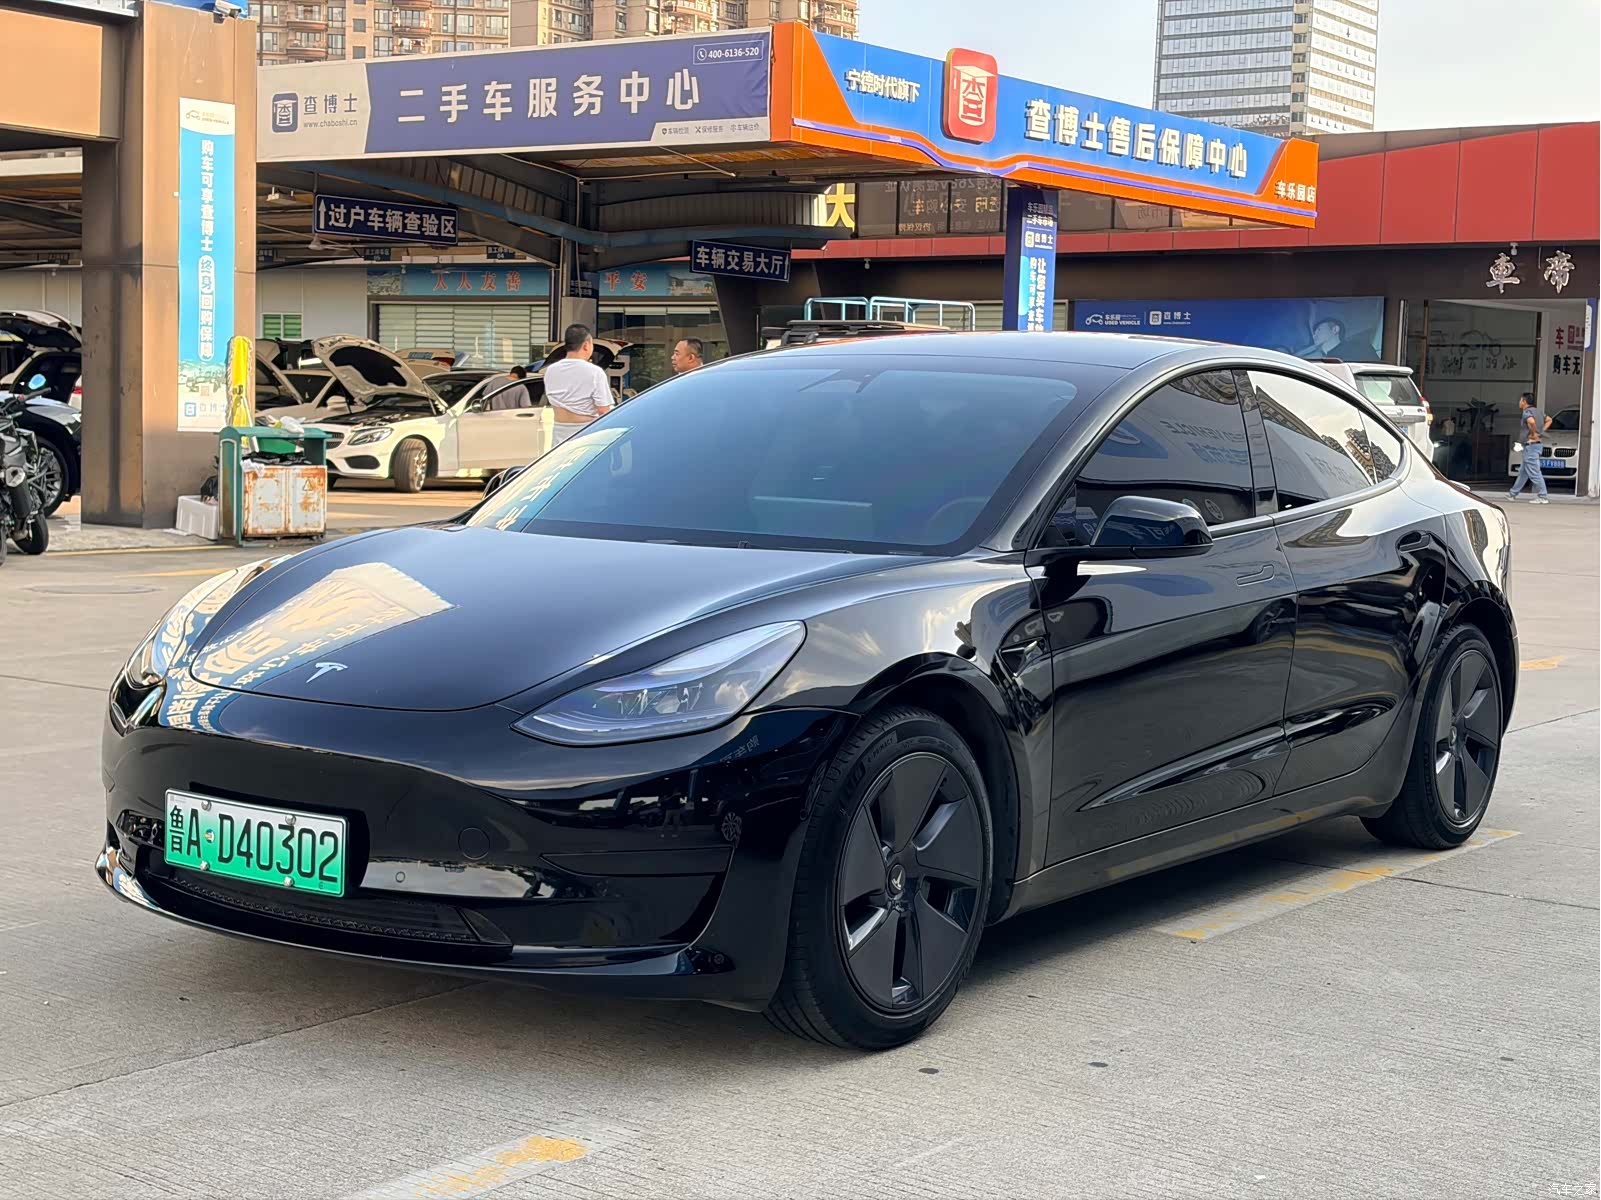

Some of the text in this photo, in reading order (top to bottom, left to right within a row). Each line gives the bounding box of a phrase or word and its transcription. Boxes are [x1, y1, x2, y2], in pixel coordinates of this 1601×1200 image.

[708, 47, 760, 59] 400-6136-520
[398, 68, 700, 123] 二手车服务中心
[845, 68, 921, 103] 宁德时代旗下
[303, 93, 358, 116] 查博士
[303, 119, 358, 128] www.chaboshi.cn
[1025, 98, 1248, 179] 查博士售后保障中心
[1275, 180, 1316, 205] 车乐园店
[328, 203, 456, 238] 过户车辆查验区
[695, 245, 784, 276] 车辆交易大厅
[432, 271, 522, 292] 人人友善
[604, 271, 648, 292] 平安
